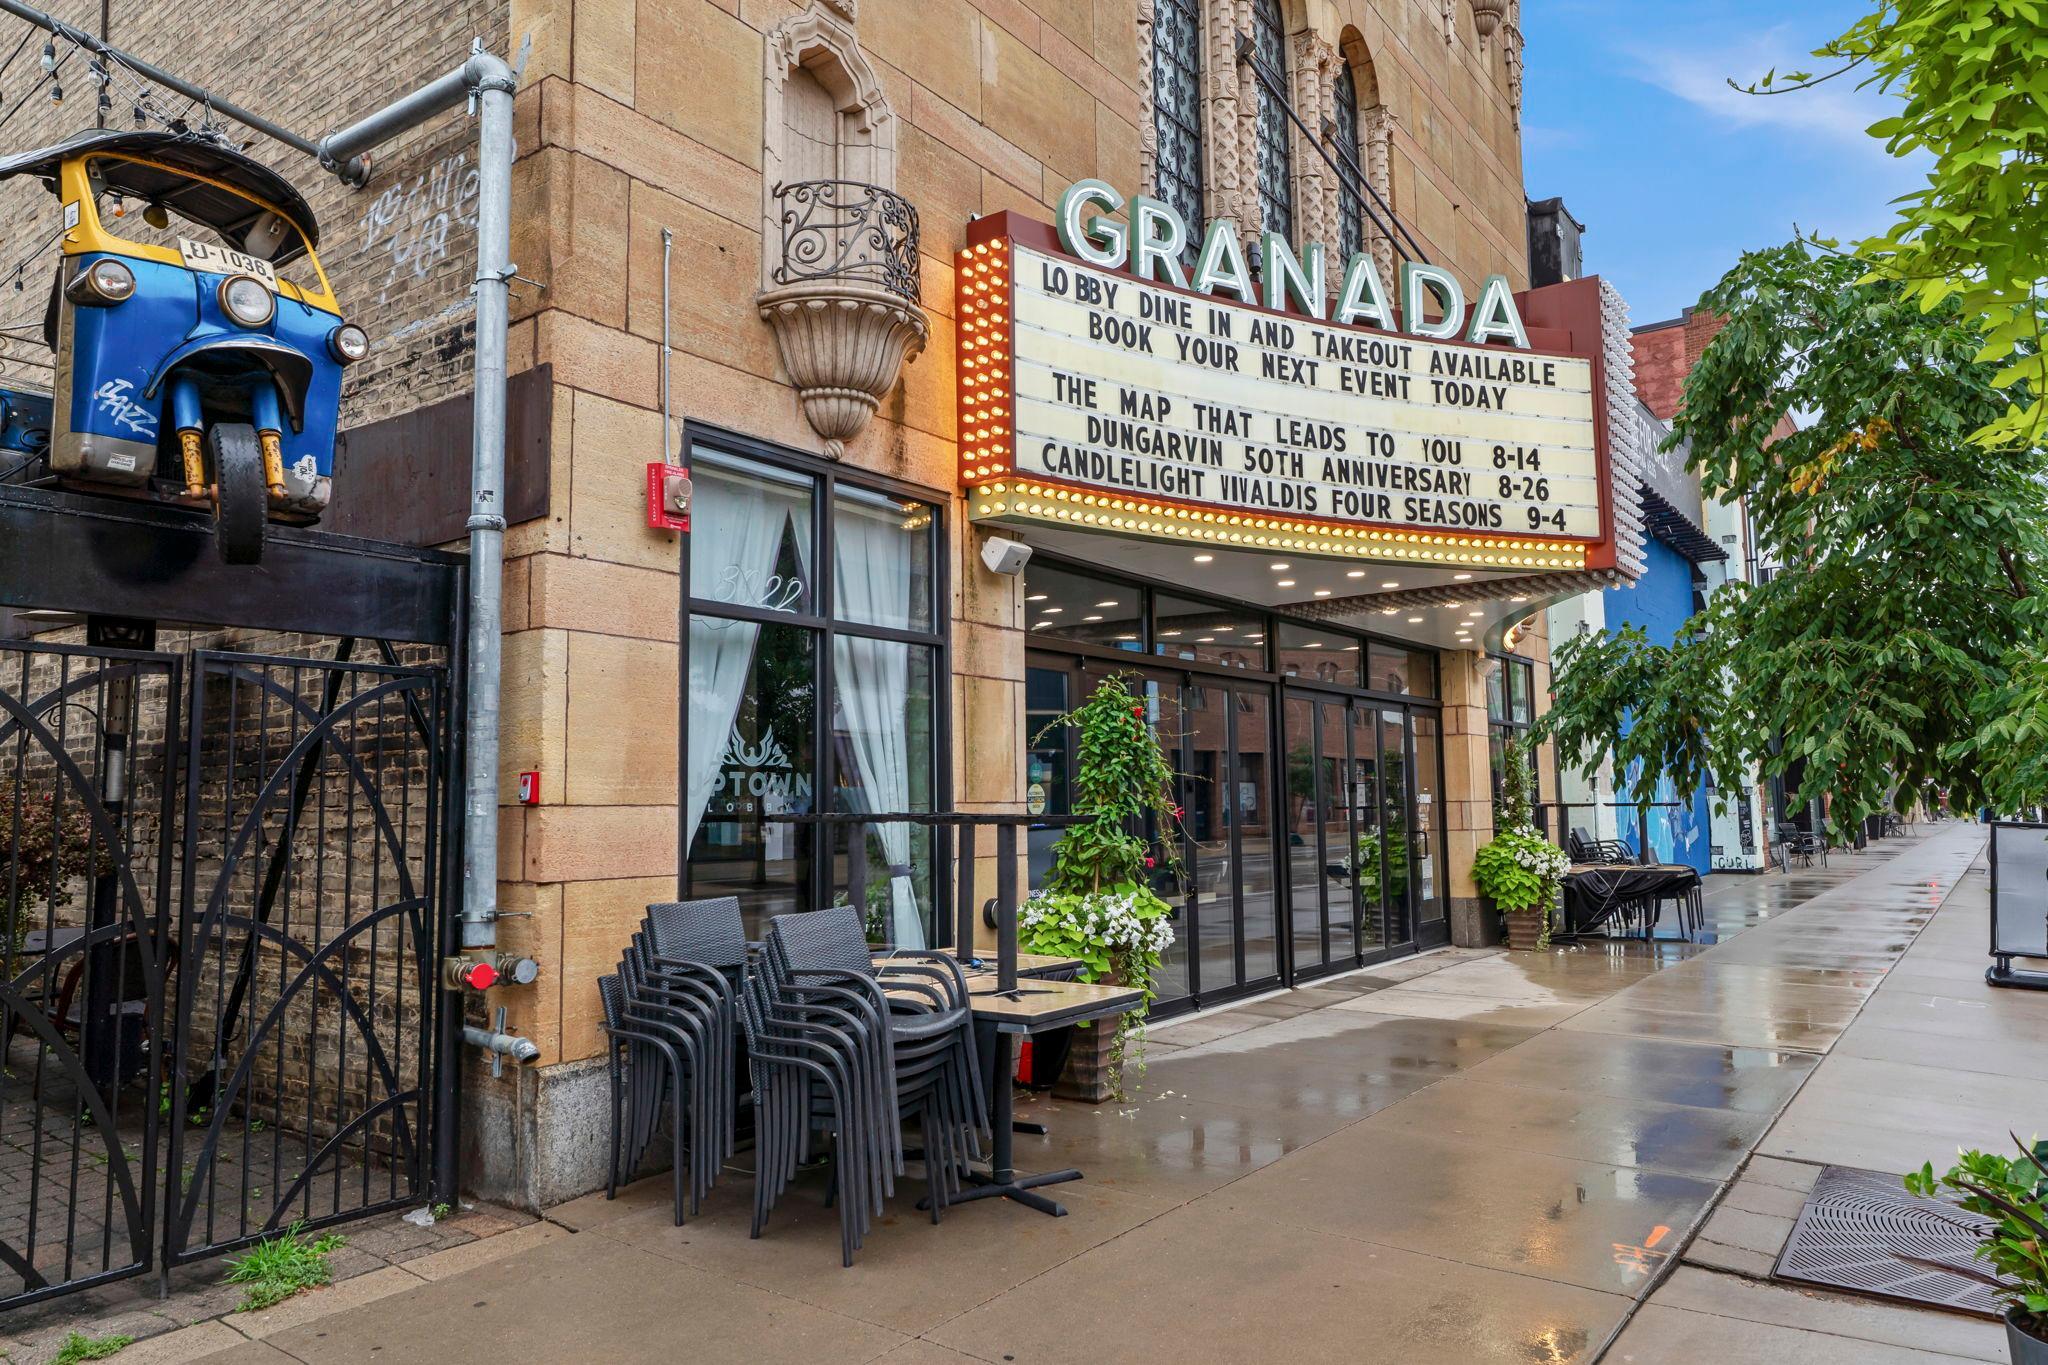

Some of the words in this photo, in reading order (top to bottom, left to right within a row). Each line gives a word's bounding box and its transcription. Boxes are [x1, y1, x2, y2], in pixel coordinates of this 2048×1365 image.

[1056, 178, 1532, 350] GRANADA
[1090, 312, 1152, 353] BOOK
[1176, 334, 1238, 371] YOUR
[1263, 353, 1318, 385] NEXT
[1341, 367, 1410, 399] EVENT
[1431, 380, 1506, 410] TODAY
[1140, 292, 1192, 329] DINE
[1210, 309, 1230, 338] IN
[1250, 319, 1294, 349] AND
[1312, 331, 1411, 369] TAKEOUT
[1430, 351, 1555, 386] AVAILABLE
[1053, 372, 1097, 408] THE
[1121, 388, 1170, 422] MAP
[1194, 404, 1252, 438] THAT
[1277, 418, 1346, 452] LEADS
[1367, 432, 1394, 457] TO
[1423, 439, 1461, 465] YOU
[1493, 446, 1540, 471] 8-14
[1088, 416, 1222, 466] DUNGARVIN
[1245, 446, 1303, 478] 50TH
[1322, 457, 1470, 496] ANNIVERSARY
[1499, 475, 1549, 501] 8-26
[1043, 443, 1204, 496] CANDLELIGHT
[1221, 475, 1317, 511] VIVALDIS
[1332, 490, 1391, 519] FOUR
[1405, 498, 1502, 527] SEASONS
[1528, 507, 1566, 531] 9-4
[707, 802, 792, 813] LOBBY
